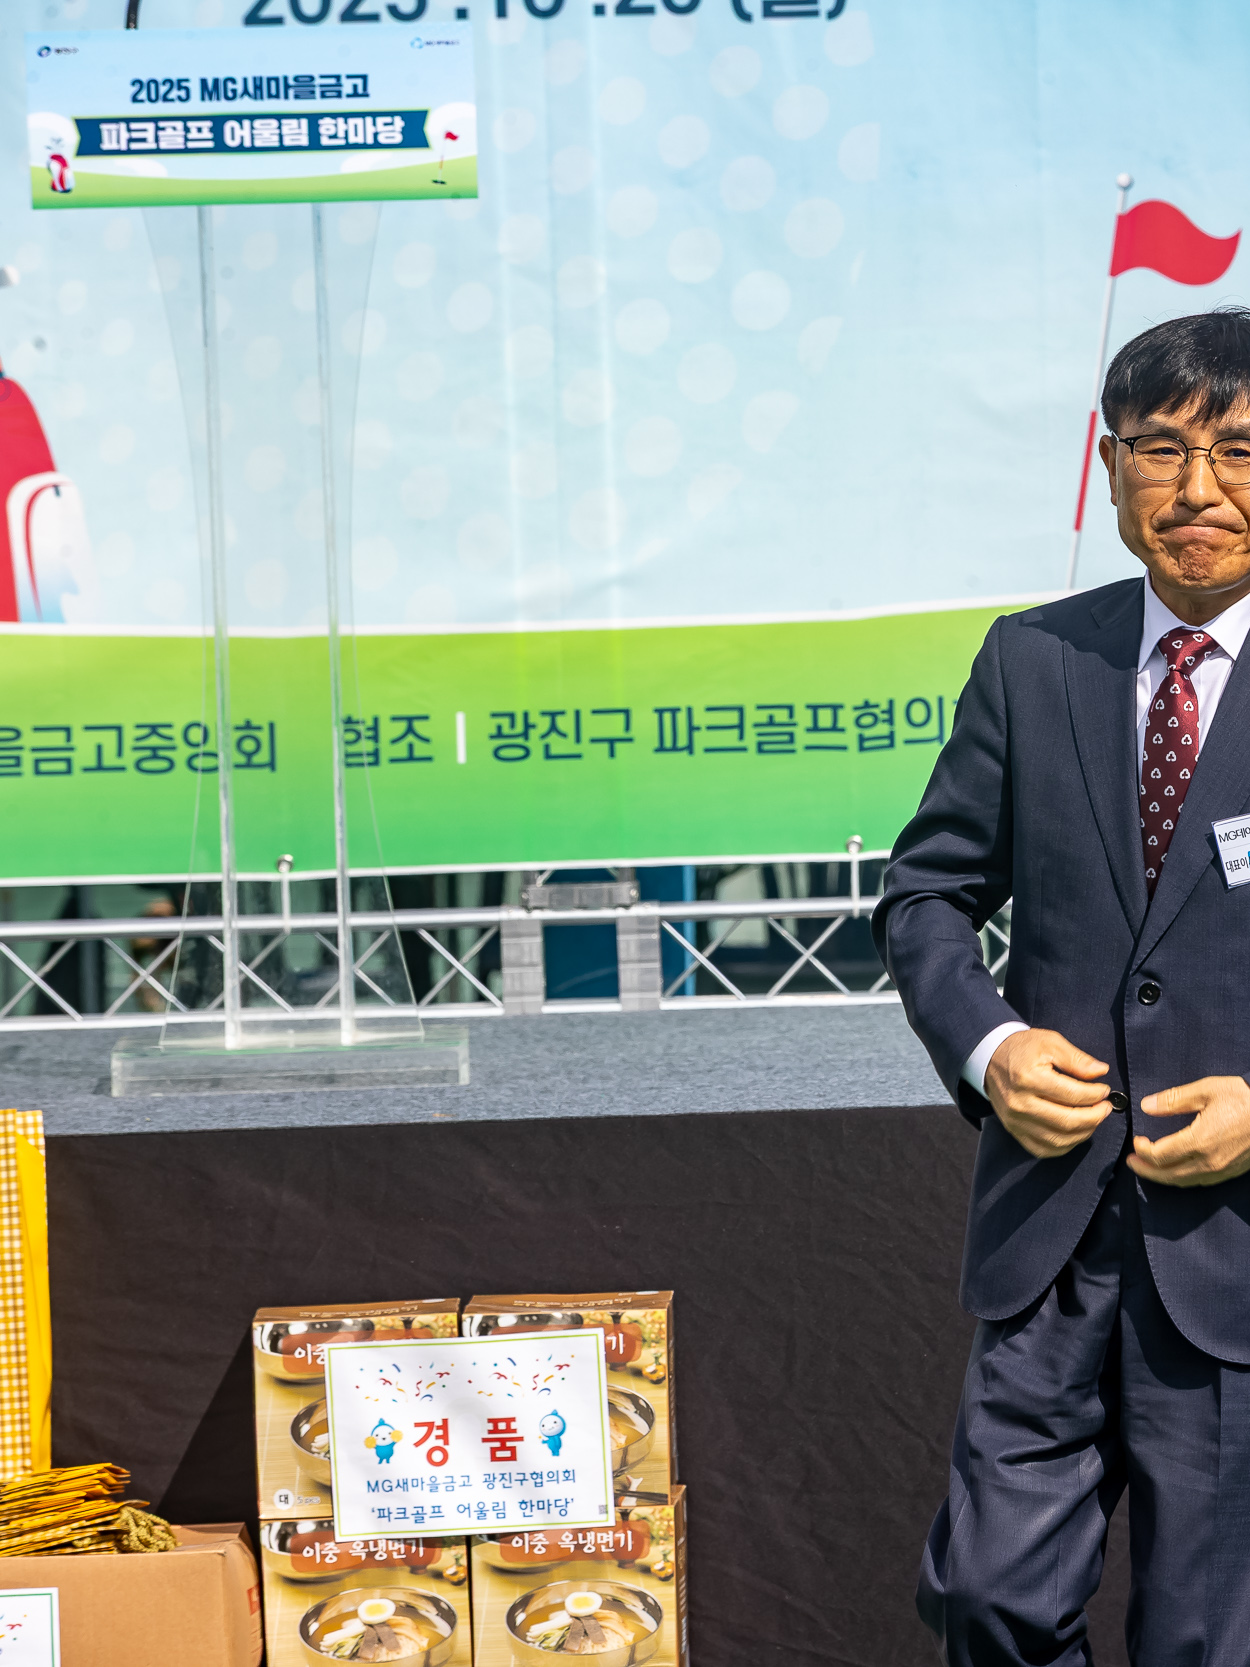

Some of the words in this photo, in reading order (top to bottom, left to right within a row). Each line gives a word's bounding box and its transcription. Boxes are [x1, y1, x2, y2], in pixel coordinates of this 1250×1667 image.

[130, 77, 191, 104] 2025
[199, 73, 370, 102] MG새마을금고
[99, 120, 215, 151] 파크골프
[223, 117, 309, 148] 어울림
[318, 115, 405, 146] 한마당
[342, 713, 435, 768] 협조
[488, 708, 635, 763] 광진구
[652, 694, 957, 756] 파크골프협의
[366, 1475, 473, 1493] MG새마을금고
[482, 1469, 576, 1491] 광진구협의회
[456, 1501, 507, 1521] 어울림
[302, 1541, 341, 1564] 이중
[511, 1532, 550, 1555] 이중
[557, 1529, 634, 1555] 옥냉면기
